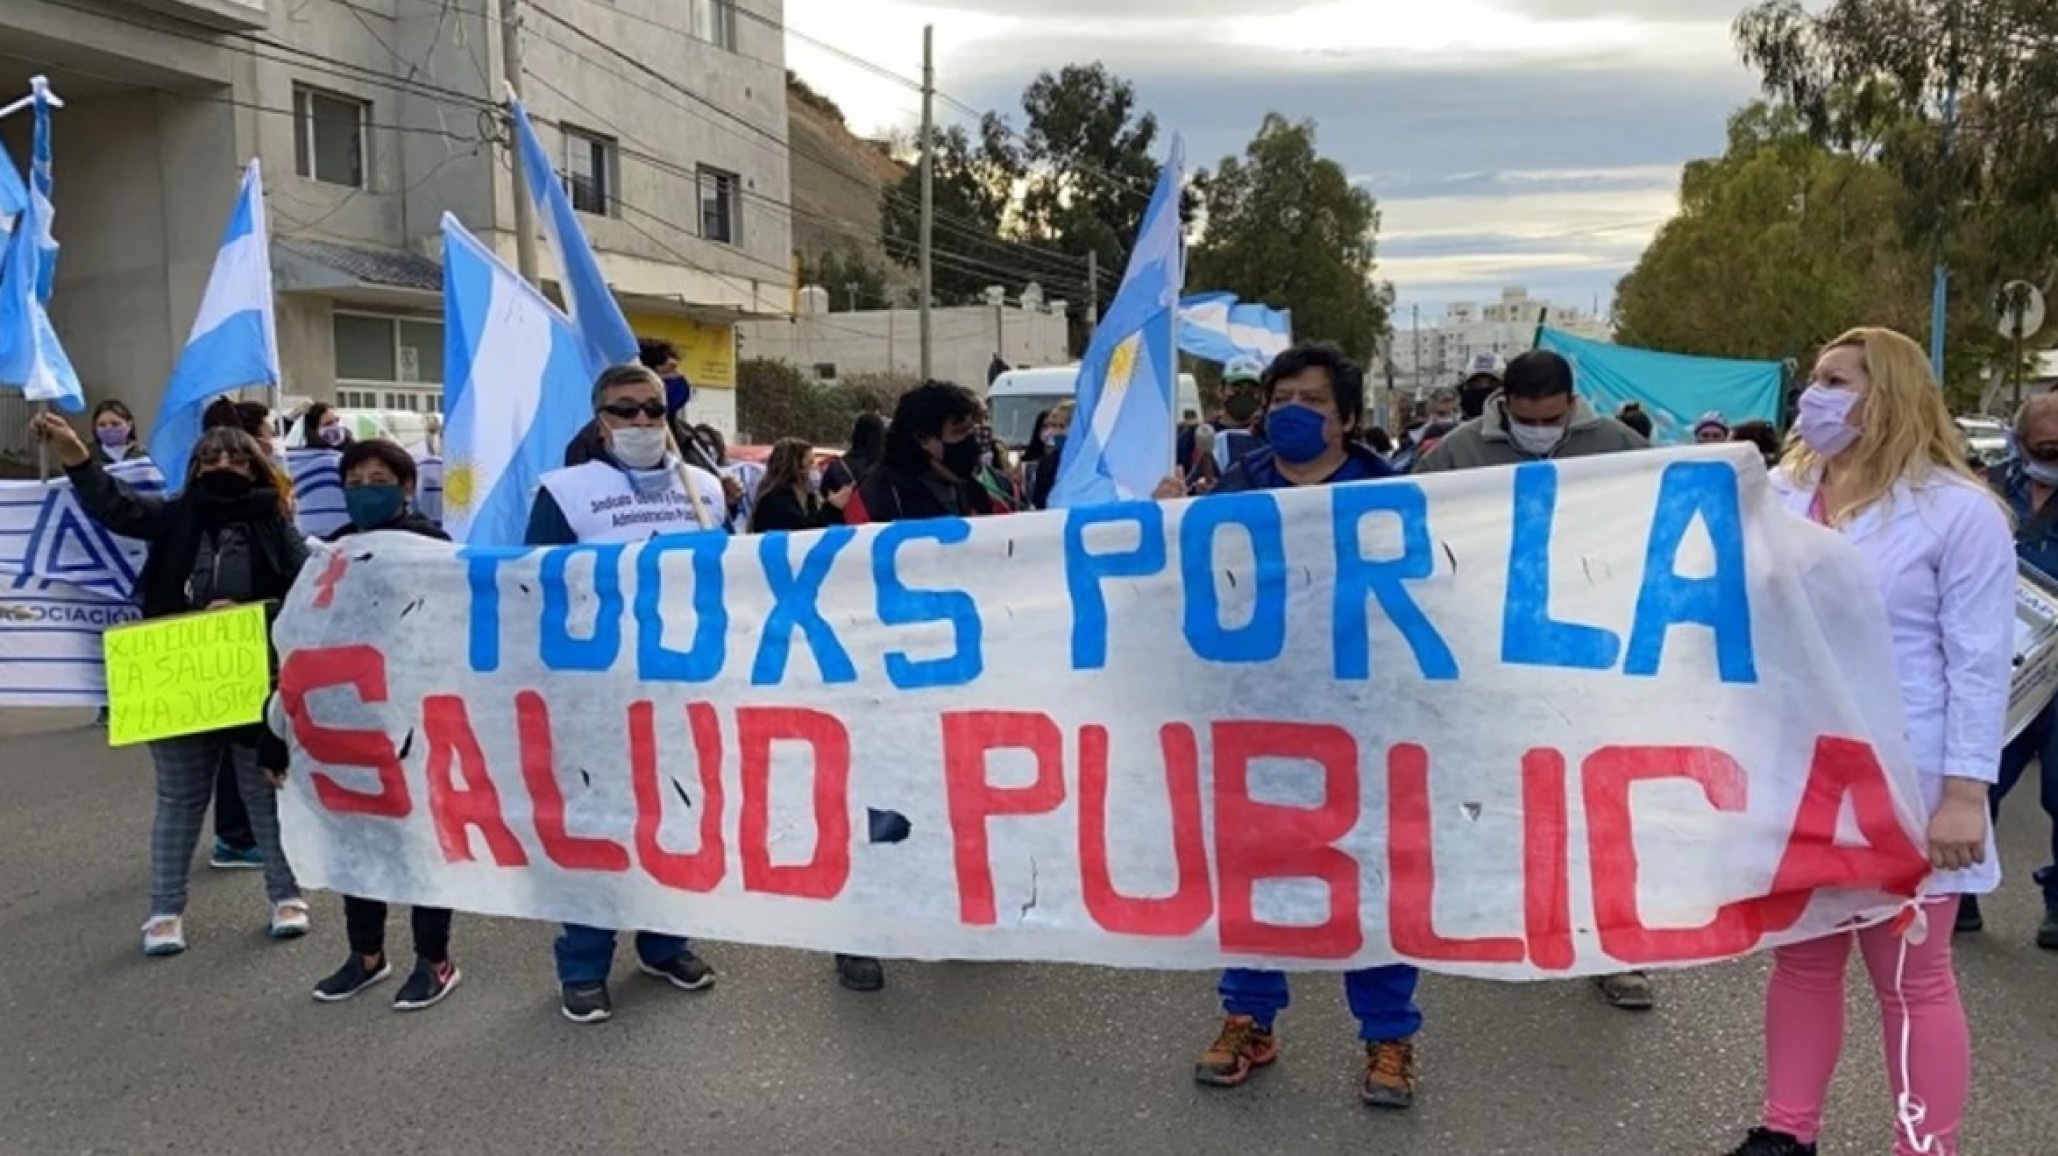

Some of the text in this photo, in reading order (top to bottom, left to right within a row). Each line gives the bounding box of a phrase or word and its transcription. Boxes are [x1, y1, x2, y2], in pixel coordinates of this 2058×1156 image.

[1065, 482, 1459, 681] POR
[1500, 460, 1758, 684] LA
[111, 647, 255, 698] LA SALUD
[114, 704, 130, 735] Y
[139, 695, 172, 734] LA
[279, 644, 1932, 970] SALUD PUBLICA
